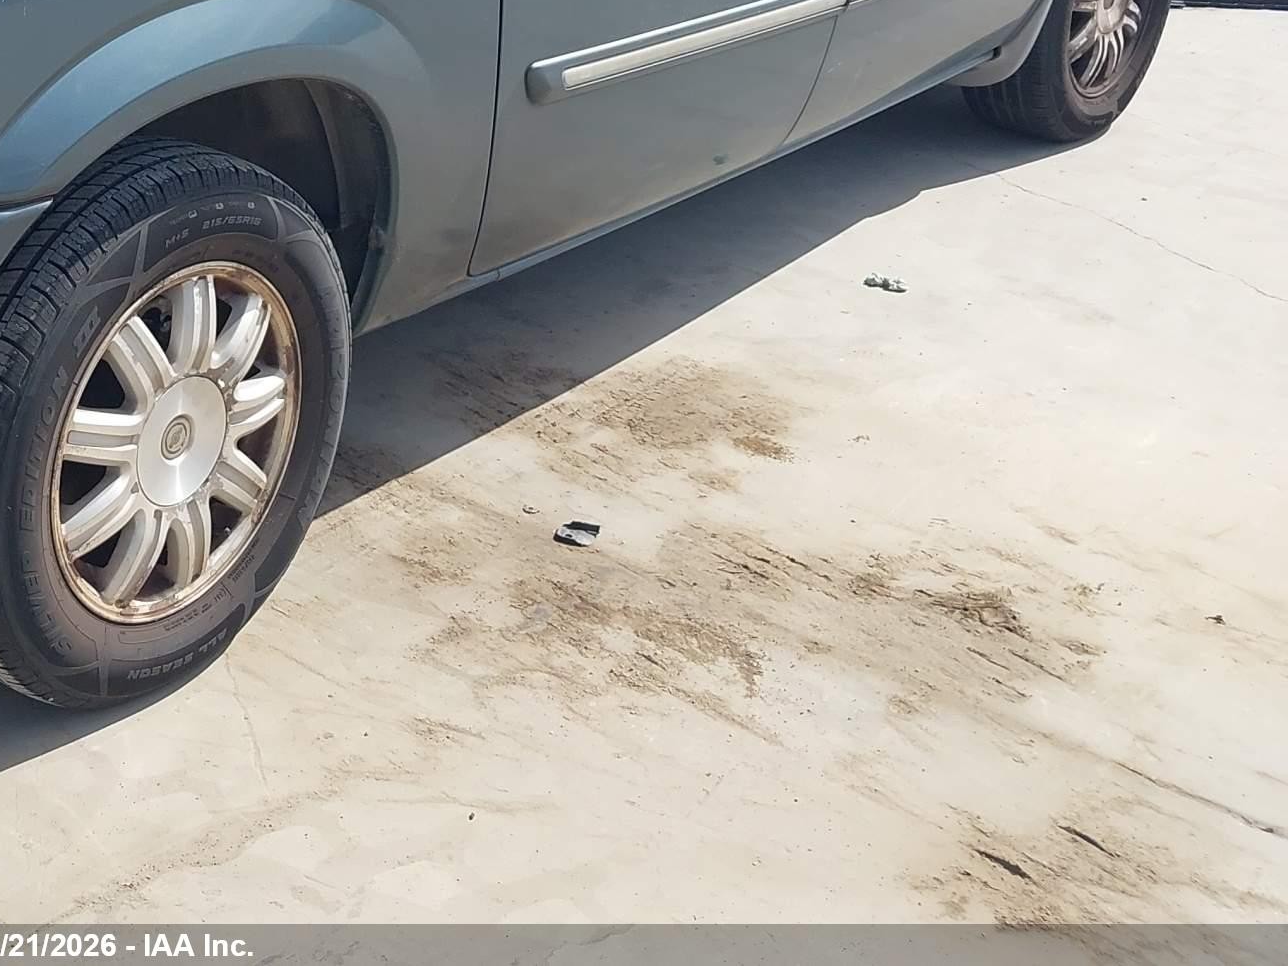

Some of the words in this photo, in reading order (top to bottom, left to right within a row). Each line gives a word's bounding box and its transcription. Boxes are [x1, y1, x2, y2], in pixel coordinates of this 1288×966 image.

[202, 216, 262, 230] 215/65R16
[19, 364, 68, 532] EDITION
[198, 627, 227, 654] ALL
[127, 651, 193, 679] SEASON
